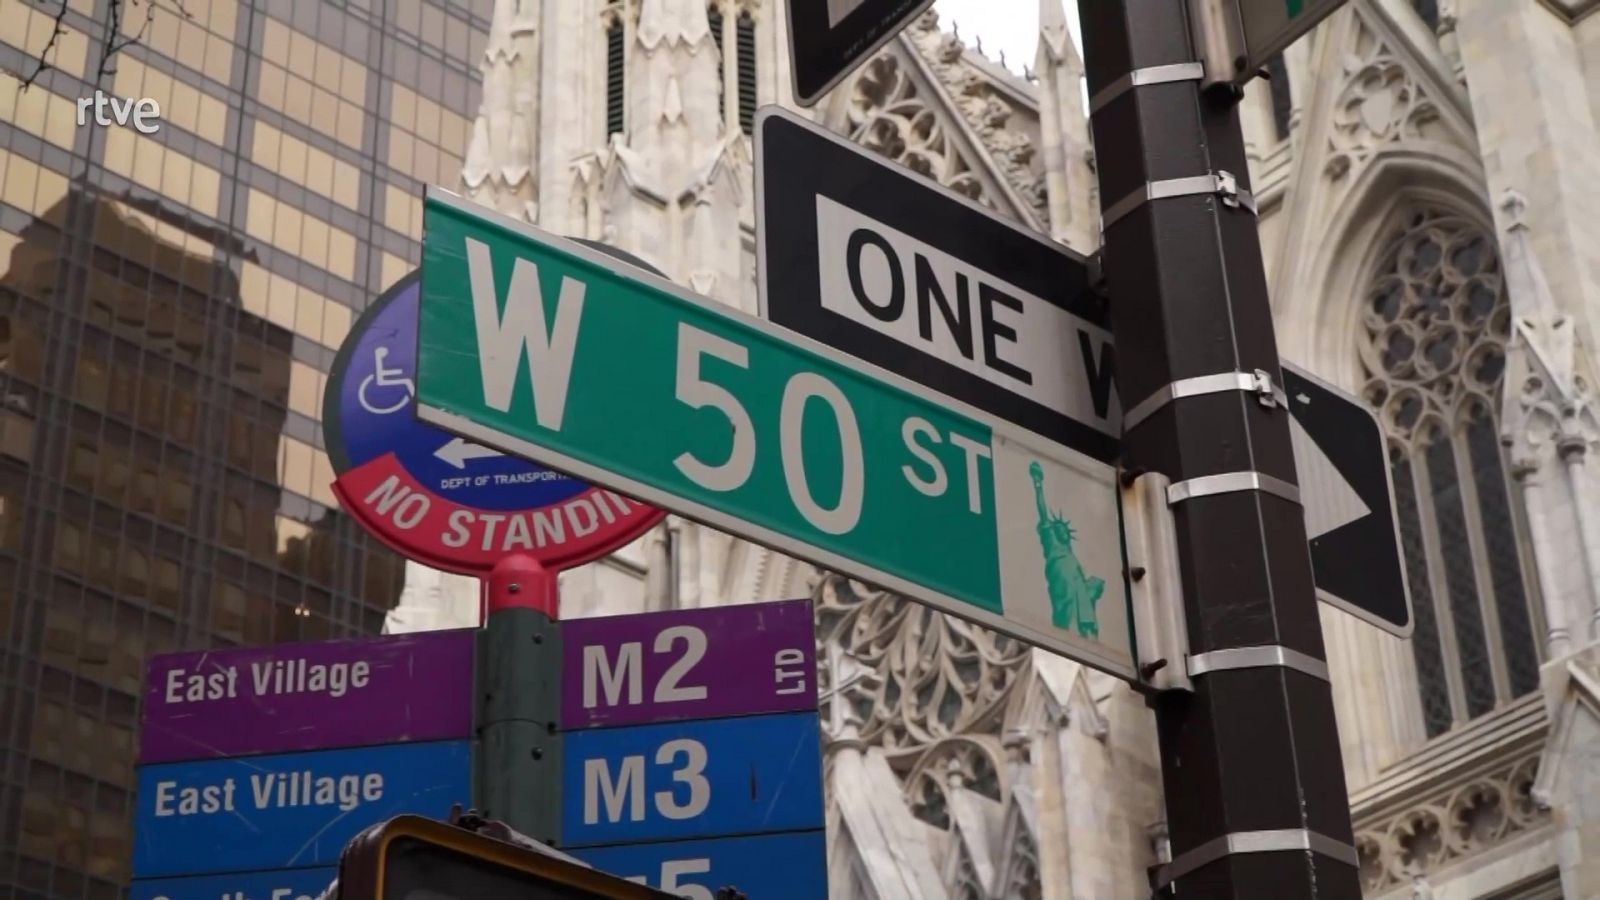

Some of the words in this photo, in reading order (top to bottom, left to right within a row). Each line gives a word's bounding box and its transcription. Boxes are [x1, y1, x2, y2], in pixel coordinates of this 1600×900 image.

[846, 228, 1033, 386] ONE
[465, 236, 586, 433] W
[672, 321, 865, 535] 50
[901, 416, 992, 515] ST
[364, 474, 430, 530] NO
[441, 476, 471, 489] DEPT
[475, 475, 490, 486] OF
[165, 666, 238, 703] East
[251, 658, 370, 697] Village
[583, 625, 708, 708] M2
[775, 648, 806, 695] LTD
[155, 778, 236, 816] East
[250, 770, 384, 811] Village
[584, 738, 711, 825] M3
